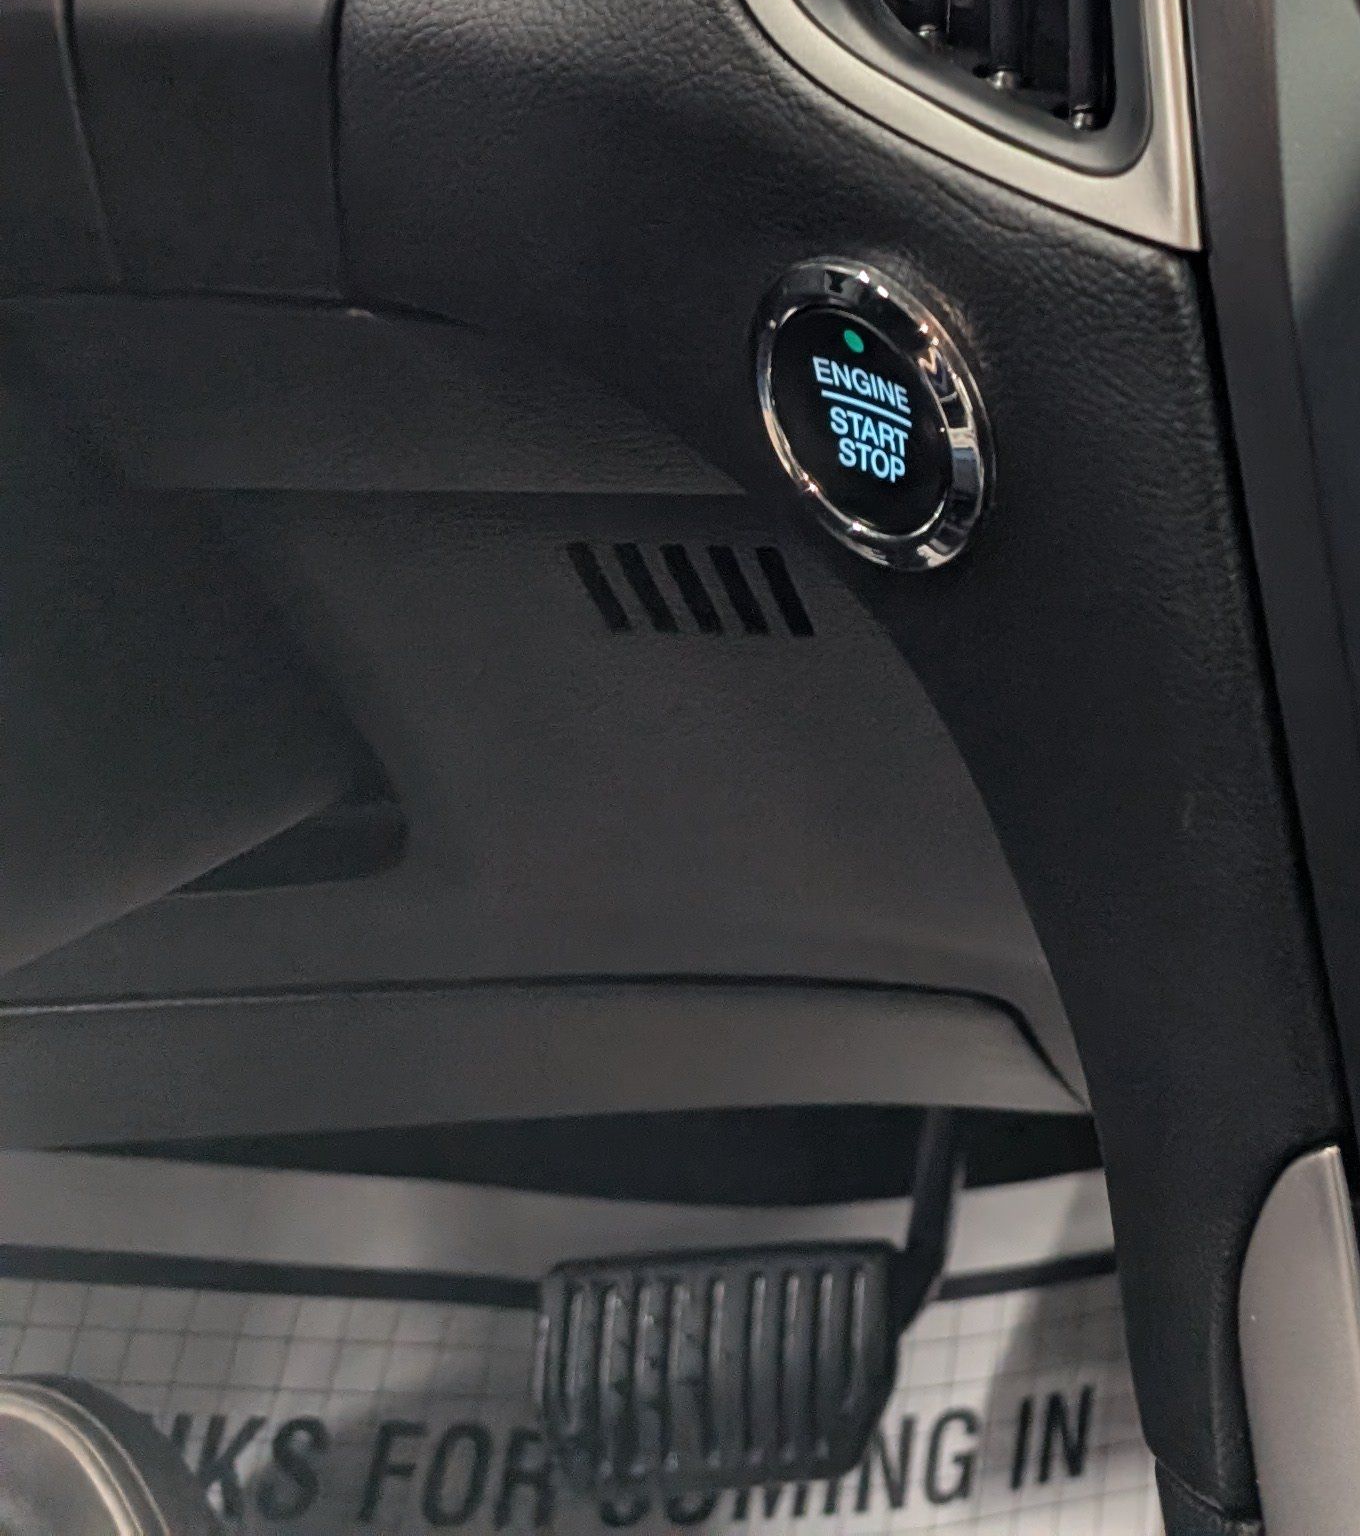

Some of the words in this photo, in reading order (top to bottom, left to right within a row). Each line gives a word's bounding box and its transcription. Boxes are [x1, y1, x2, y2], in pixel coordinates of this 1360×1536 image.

[812, 356, 911, 415] ENGINE
[829, 406, 909, 457] START
[838, 439, 906, 484] STOP
[1010, 1384, 1096, 1492] IN
[150, 1412, 330, 1524] KS
